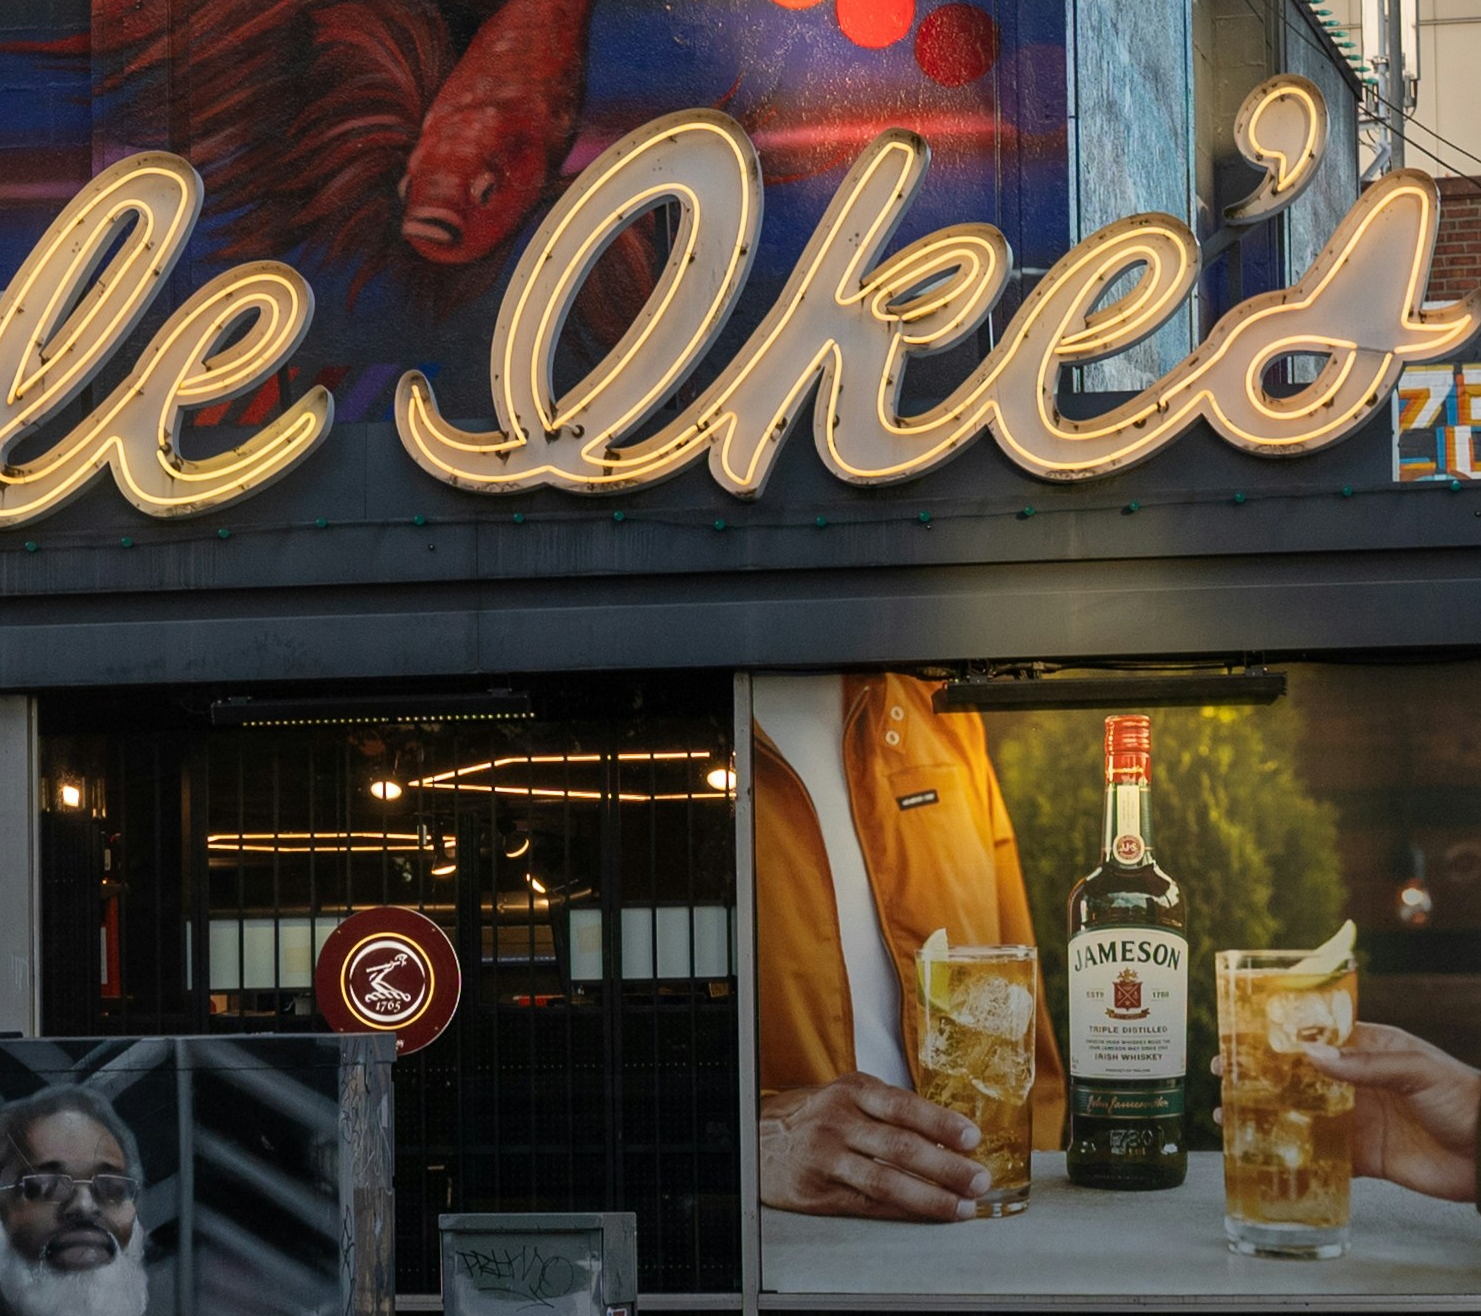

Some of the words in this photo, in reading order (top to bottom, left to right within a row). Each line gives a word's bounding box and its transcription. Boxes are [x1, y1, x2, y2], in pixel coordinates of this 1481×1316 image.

[1074, 940, 1181, 973] JAMESON
[375, 1000, 401, 1013] 1765
[1089, 1025, 1119, 1034] TRIPLE
[1122, 1025, 1168, 1034] DISTILLED
[1094, 1053, 1119, 1061] IRISH
[1121, 1053, 1163, 1061] WHISKEY
